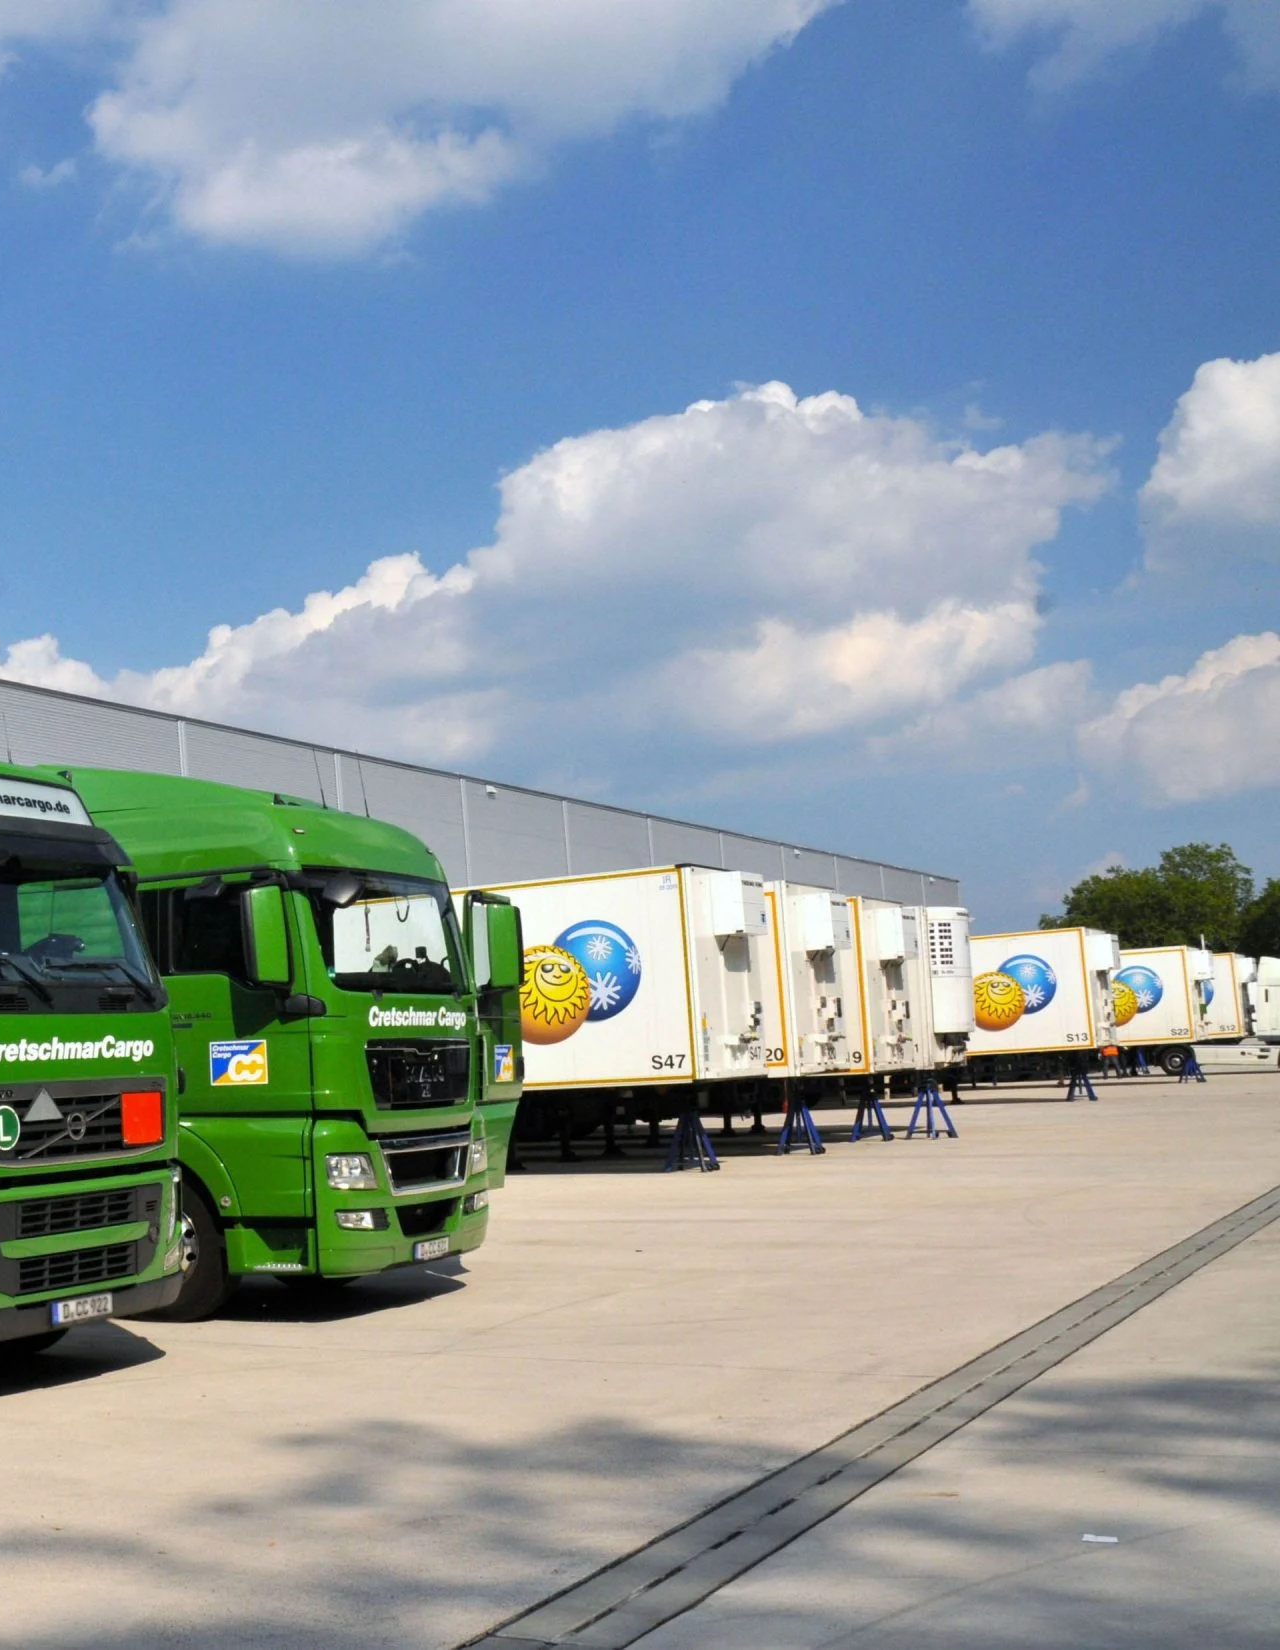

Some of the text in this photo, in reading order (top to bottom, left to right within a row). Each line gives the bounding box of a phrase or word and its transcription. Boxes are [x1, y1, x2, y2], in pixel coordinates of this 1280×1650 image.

[368, 1005, 467, 1030] Cretschmar Cargo
[1066, 1033, 1089, 1043] S13
[651, 1054, 686, 1070] S47
[0, 1115, 12, 1142] L
